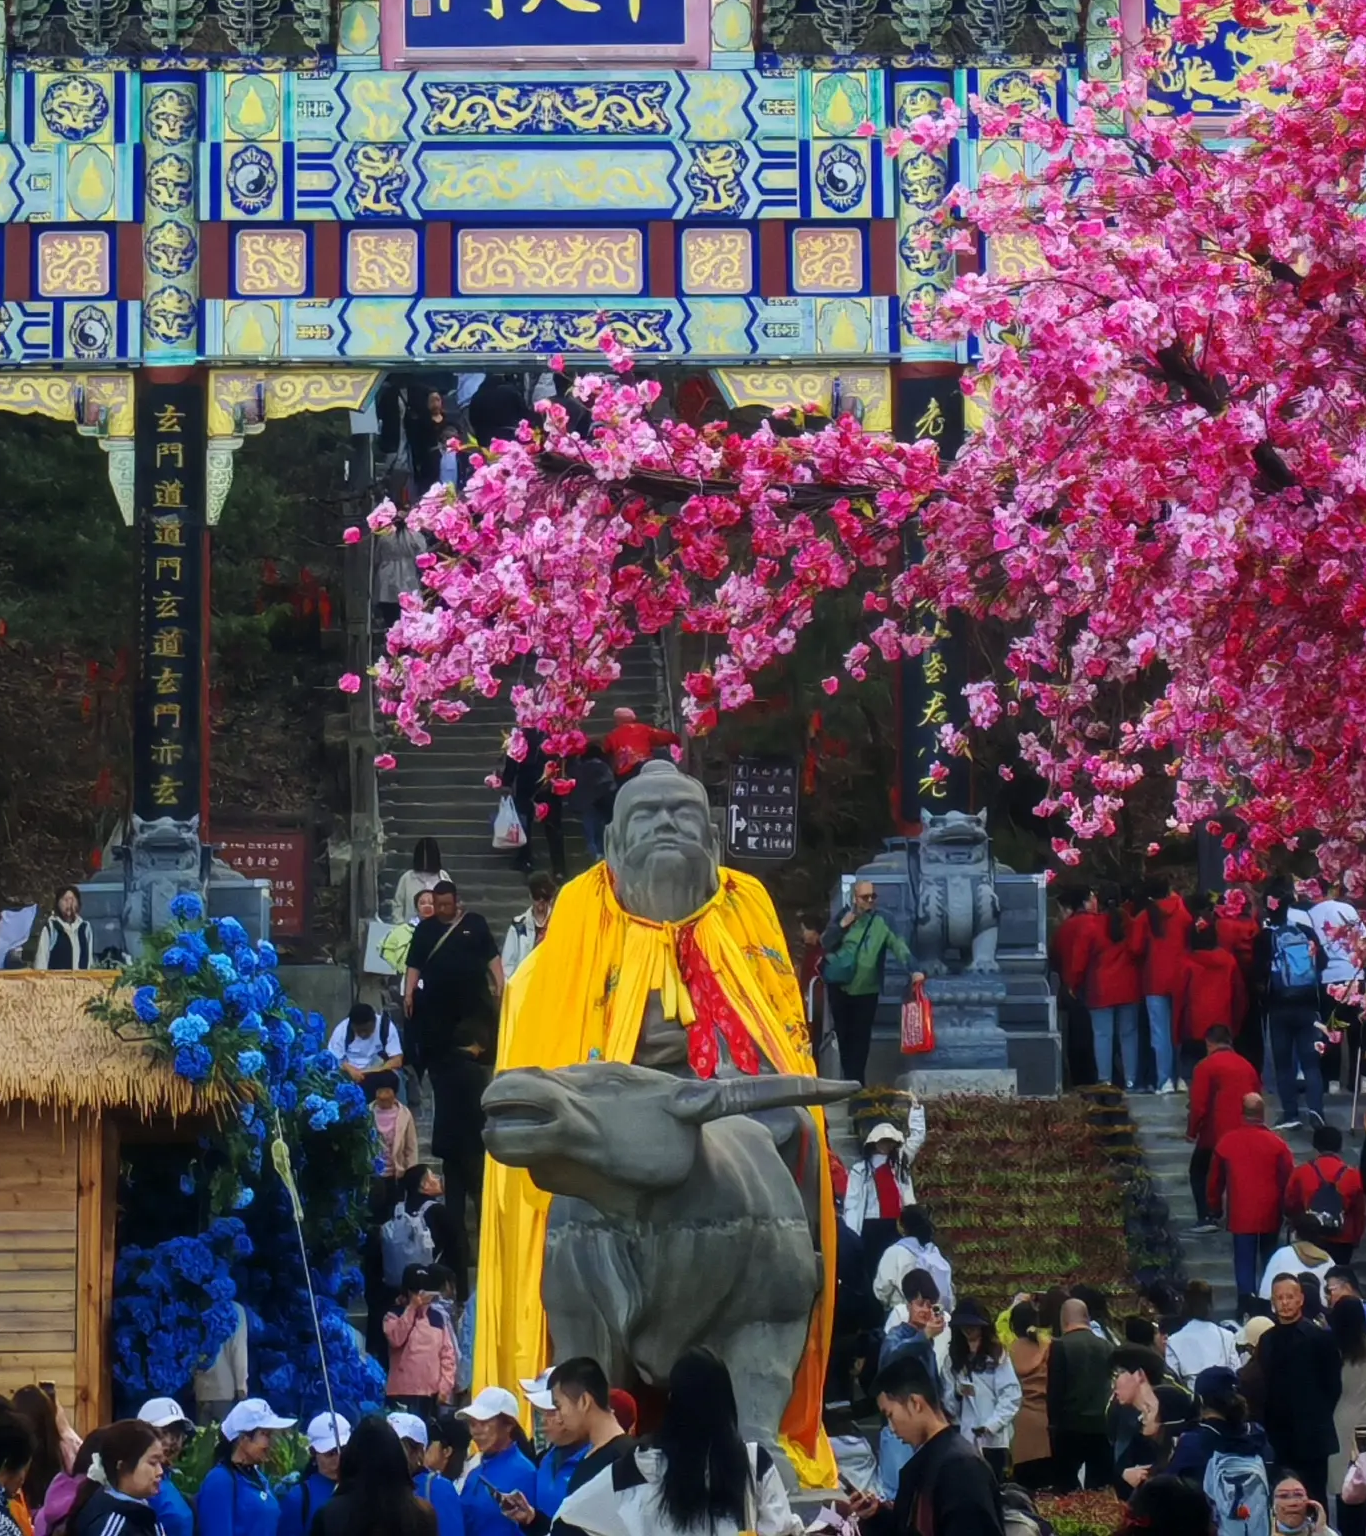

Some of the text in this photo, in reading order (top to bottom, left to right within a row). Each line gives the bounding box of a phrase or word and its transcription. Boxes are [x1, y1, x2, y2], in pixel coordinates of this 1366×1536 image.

[149, 403, 188, 807] 玄門道道門玄道玄門亦玄
